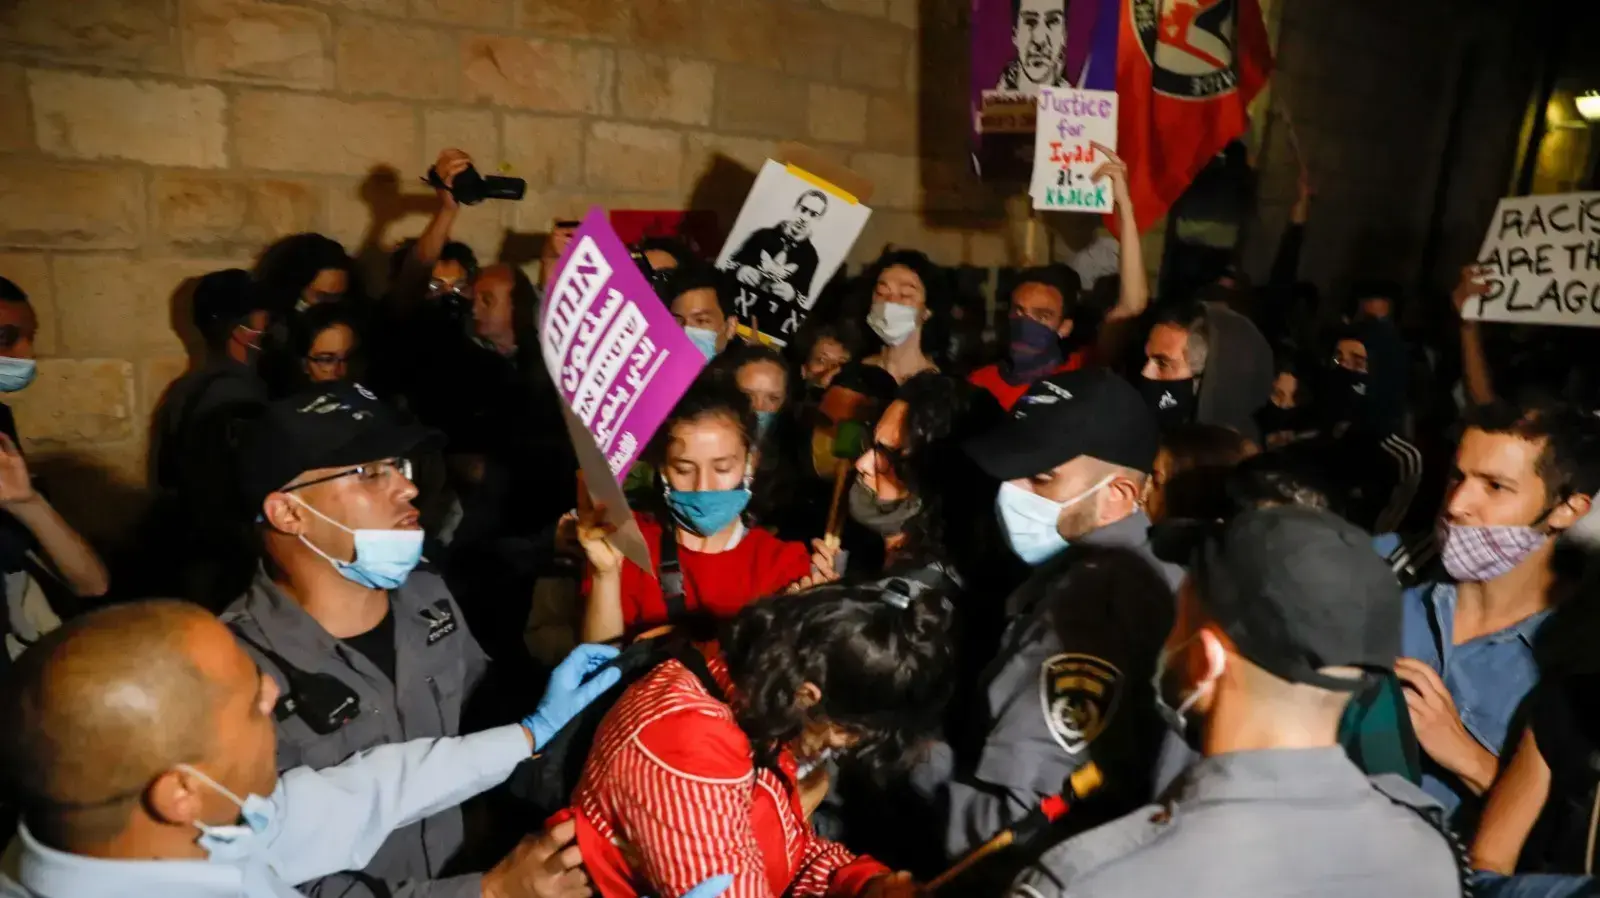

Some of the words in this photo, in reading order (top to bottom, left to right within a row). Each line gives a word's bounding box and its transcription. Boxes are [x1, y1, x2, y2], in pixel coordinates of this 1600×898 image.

[1056, 118, 1086, 140] for
[1049, 141, 1095, 169] Iyad
[1478, 244, 1554, 277] ARE
[547, 251, 599, 354] אנחנו
